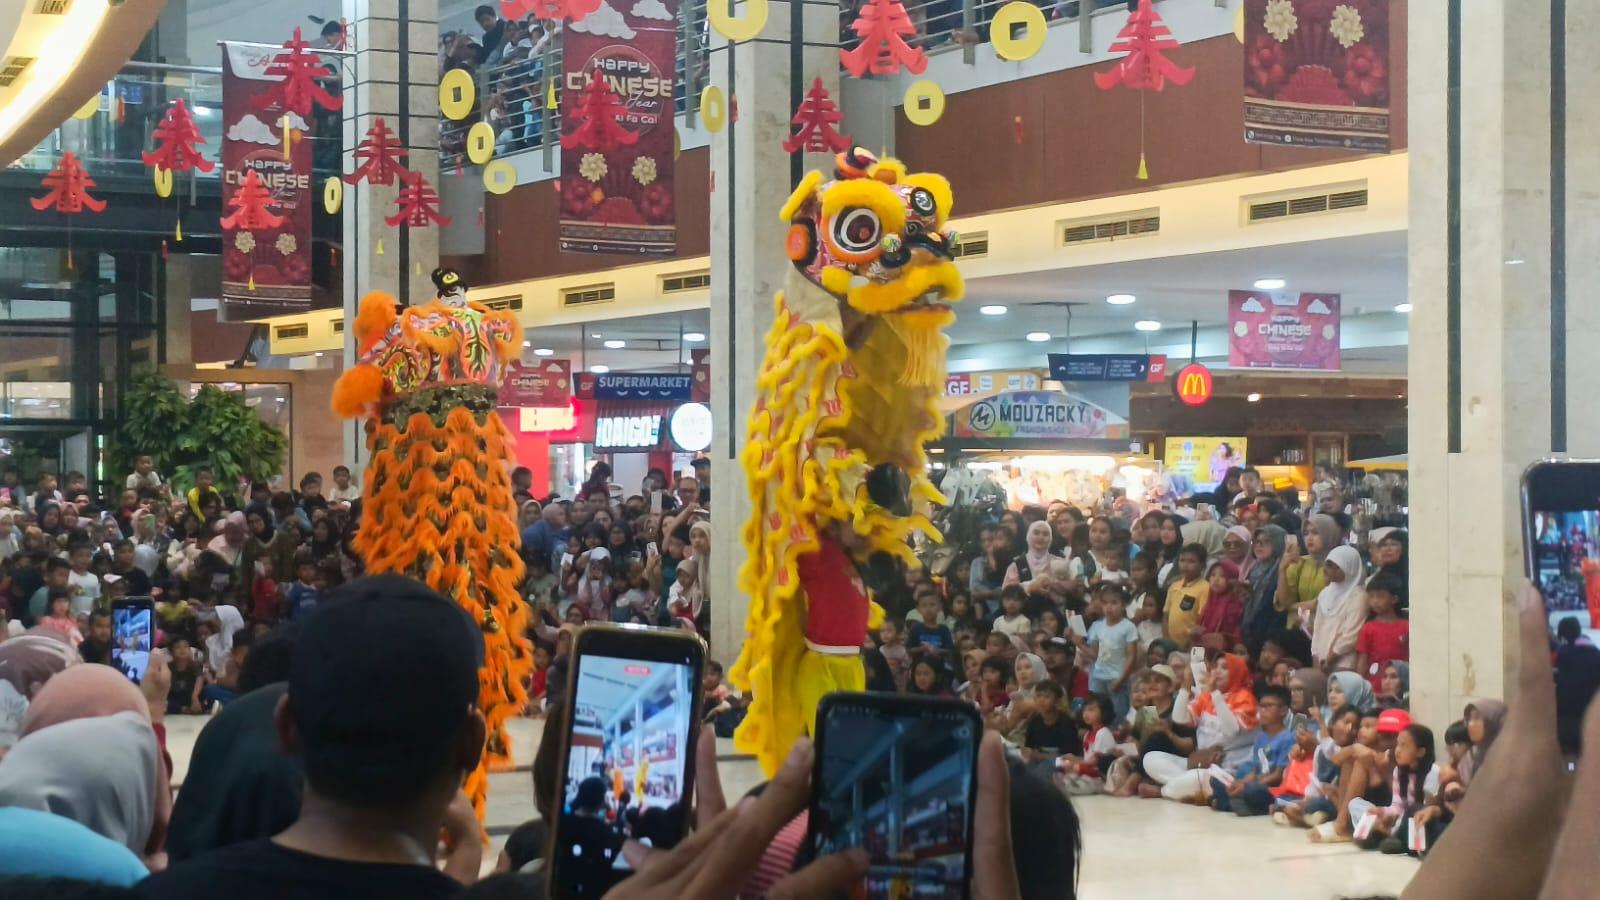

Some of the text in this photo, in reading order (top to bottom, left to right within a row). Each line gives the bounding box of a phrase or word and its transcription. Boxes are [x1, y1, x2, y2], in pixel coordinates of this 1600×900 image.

[226, 169, 309, 189] CHNESE
[1258, 323, 1312, 336] CHINESE
[1150, 363, 1164, 373] GF
[599, 376, 690, 388] SUPERMARKET
[1000, 404, 1086, 423] MOUZACKY
